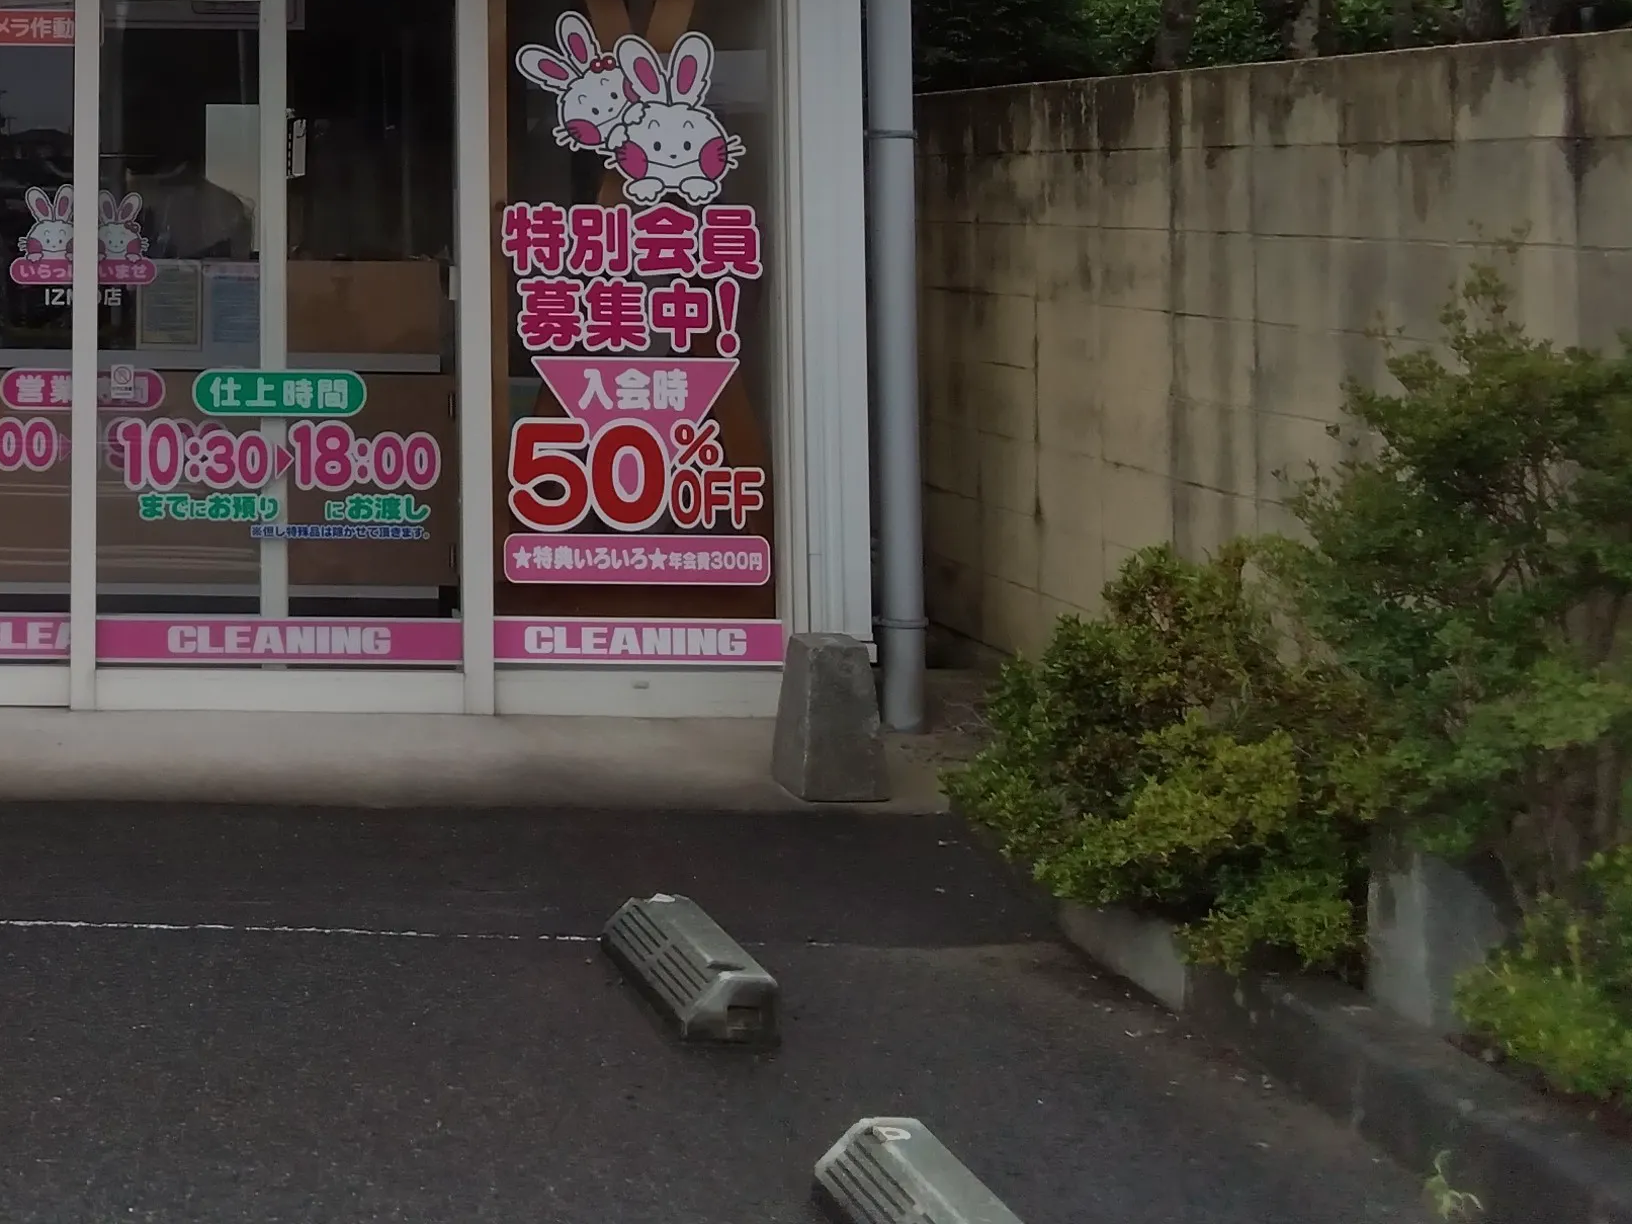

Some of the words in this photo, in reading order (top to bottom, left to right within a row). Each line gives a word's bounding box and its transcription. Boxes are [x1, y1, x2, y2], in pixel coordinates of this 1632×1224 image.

[502, 203, 764, 279] 特別会員
[19, 263, 148, 280] いらっいませ
[209, 377, 350, 410] 仕上時間
[579, 370, 690, 412] 入会時
[118, 417, 276, 491] 10:30
[288, 419, 441, 492] 18:00
[139, 493, 279, 522] までにお預り
[325, 495, 431, 522] にお渡し
[167, 626, 392, 655] CLEANING
[524, 624, 747, 657] CLEANING
